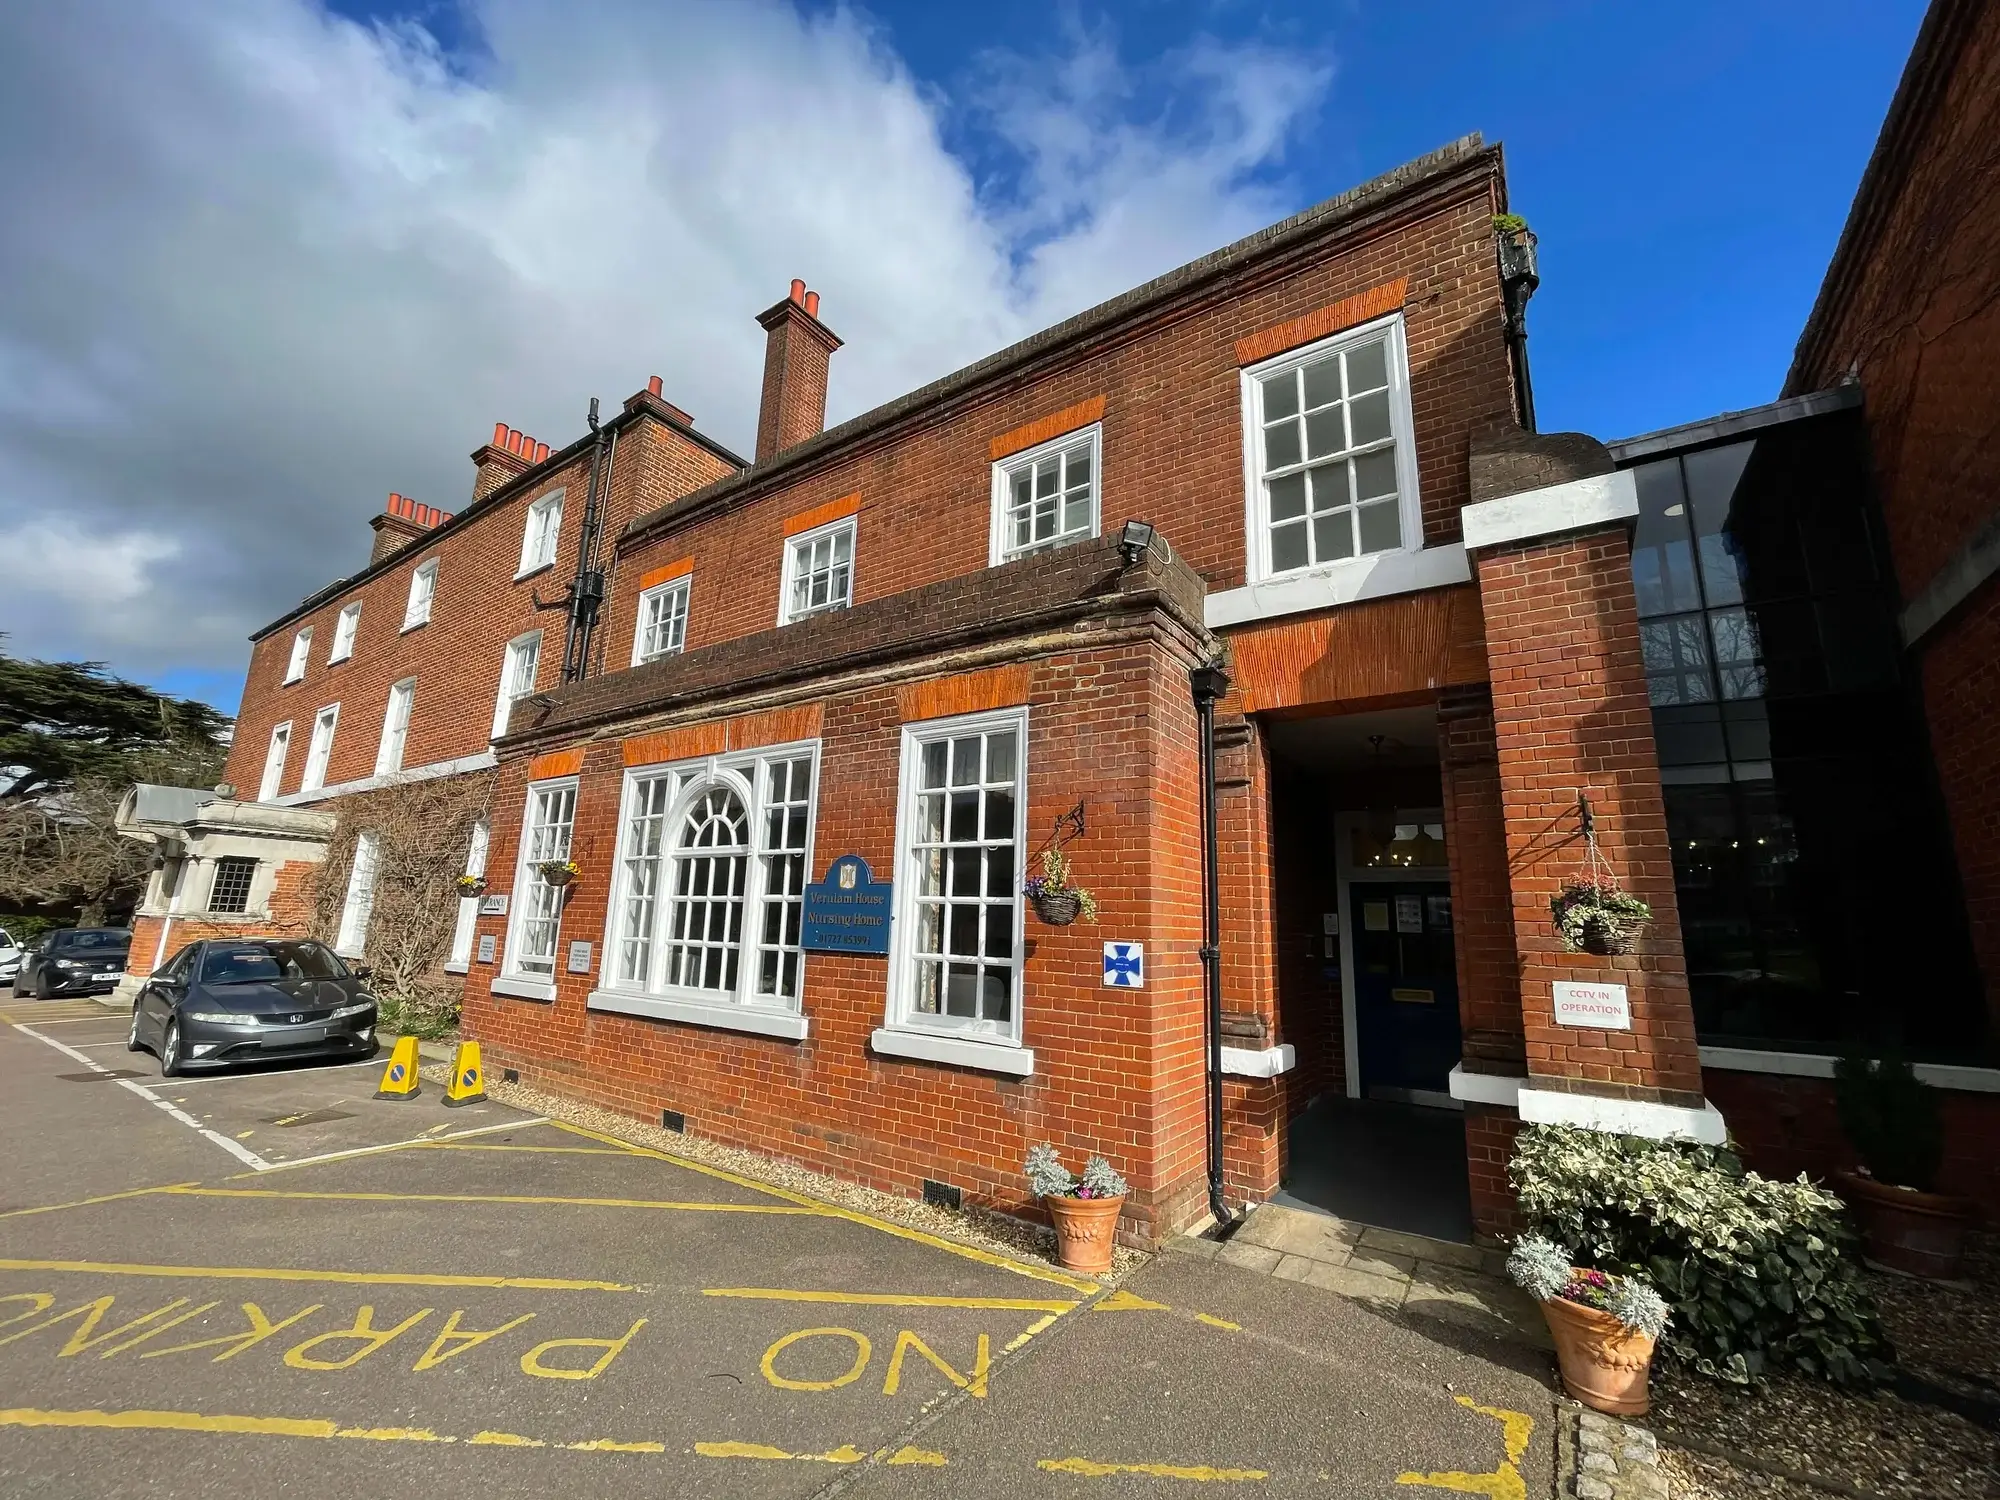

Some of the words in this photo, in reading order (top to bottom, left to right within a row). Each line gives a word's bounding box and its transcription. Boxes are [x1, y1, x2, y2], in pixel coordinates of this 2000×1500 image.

[810, 892, 852, 904] Verulam
[855, 892, 884, 905] House
[808, 911, 852, 928] Nursing
[853, 912, 883, 926] Home
[1570, 990, 1595, 999] CCTV
[1598, 991, 1610, 1000] IN
[1561, 1003, 1622, 1015] OPERATION
[759, 1327, 990, 1398] NO
